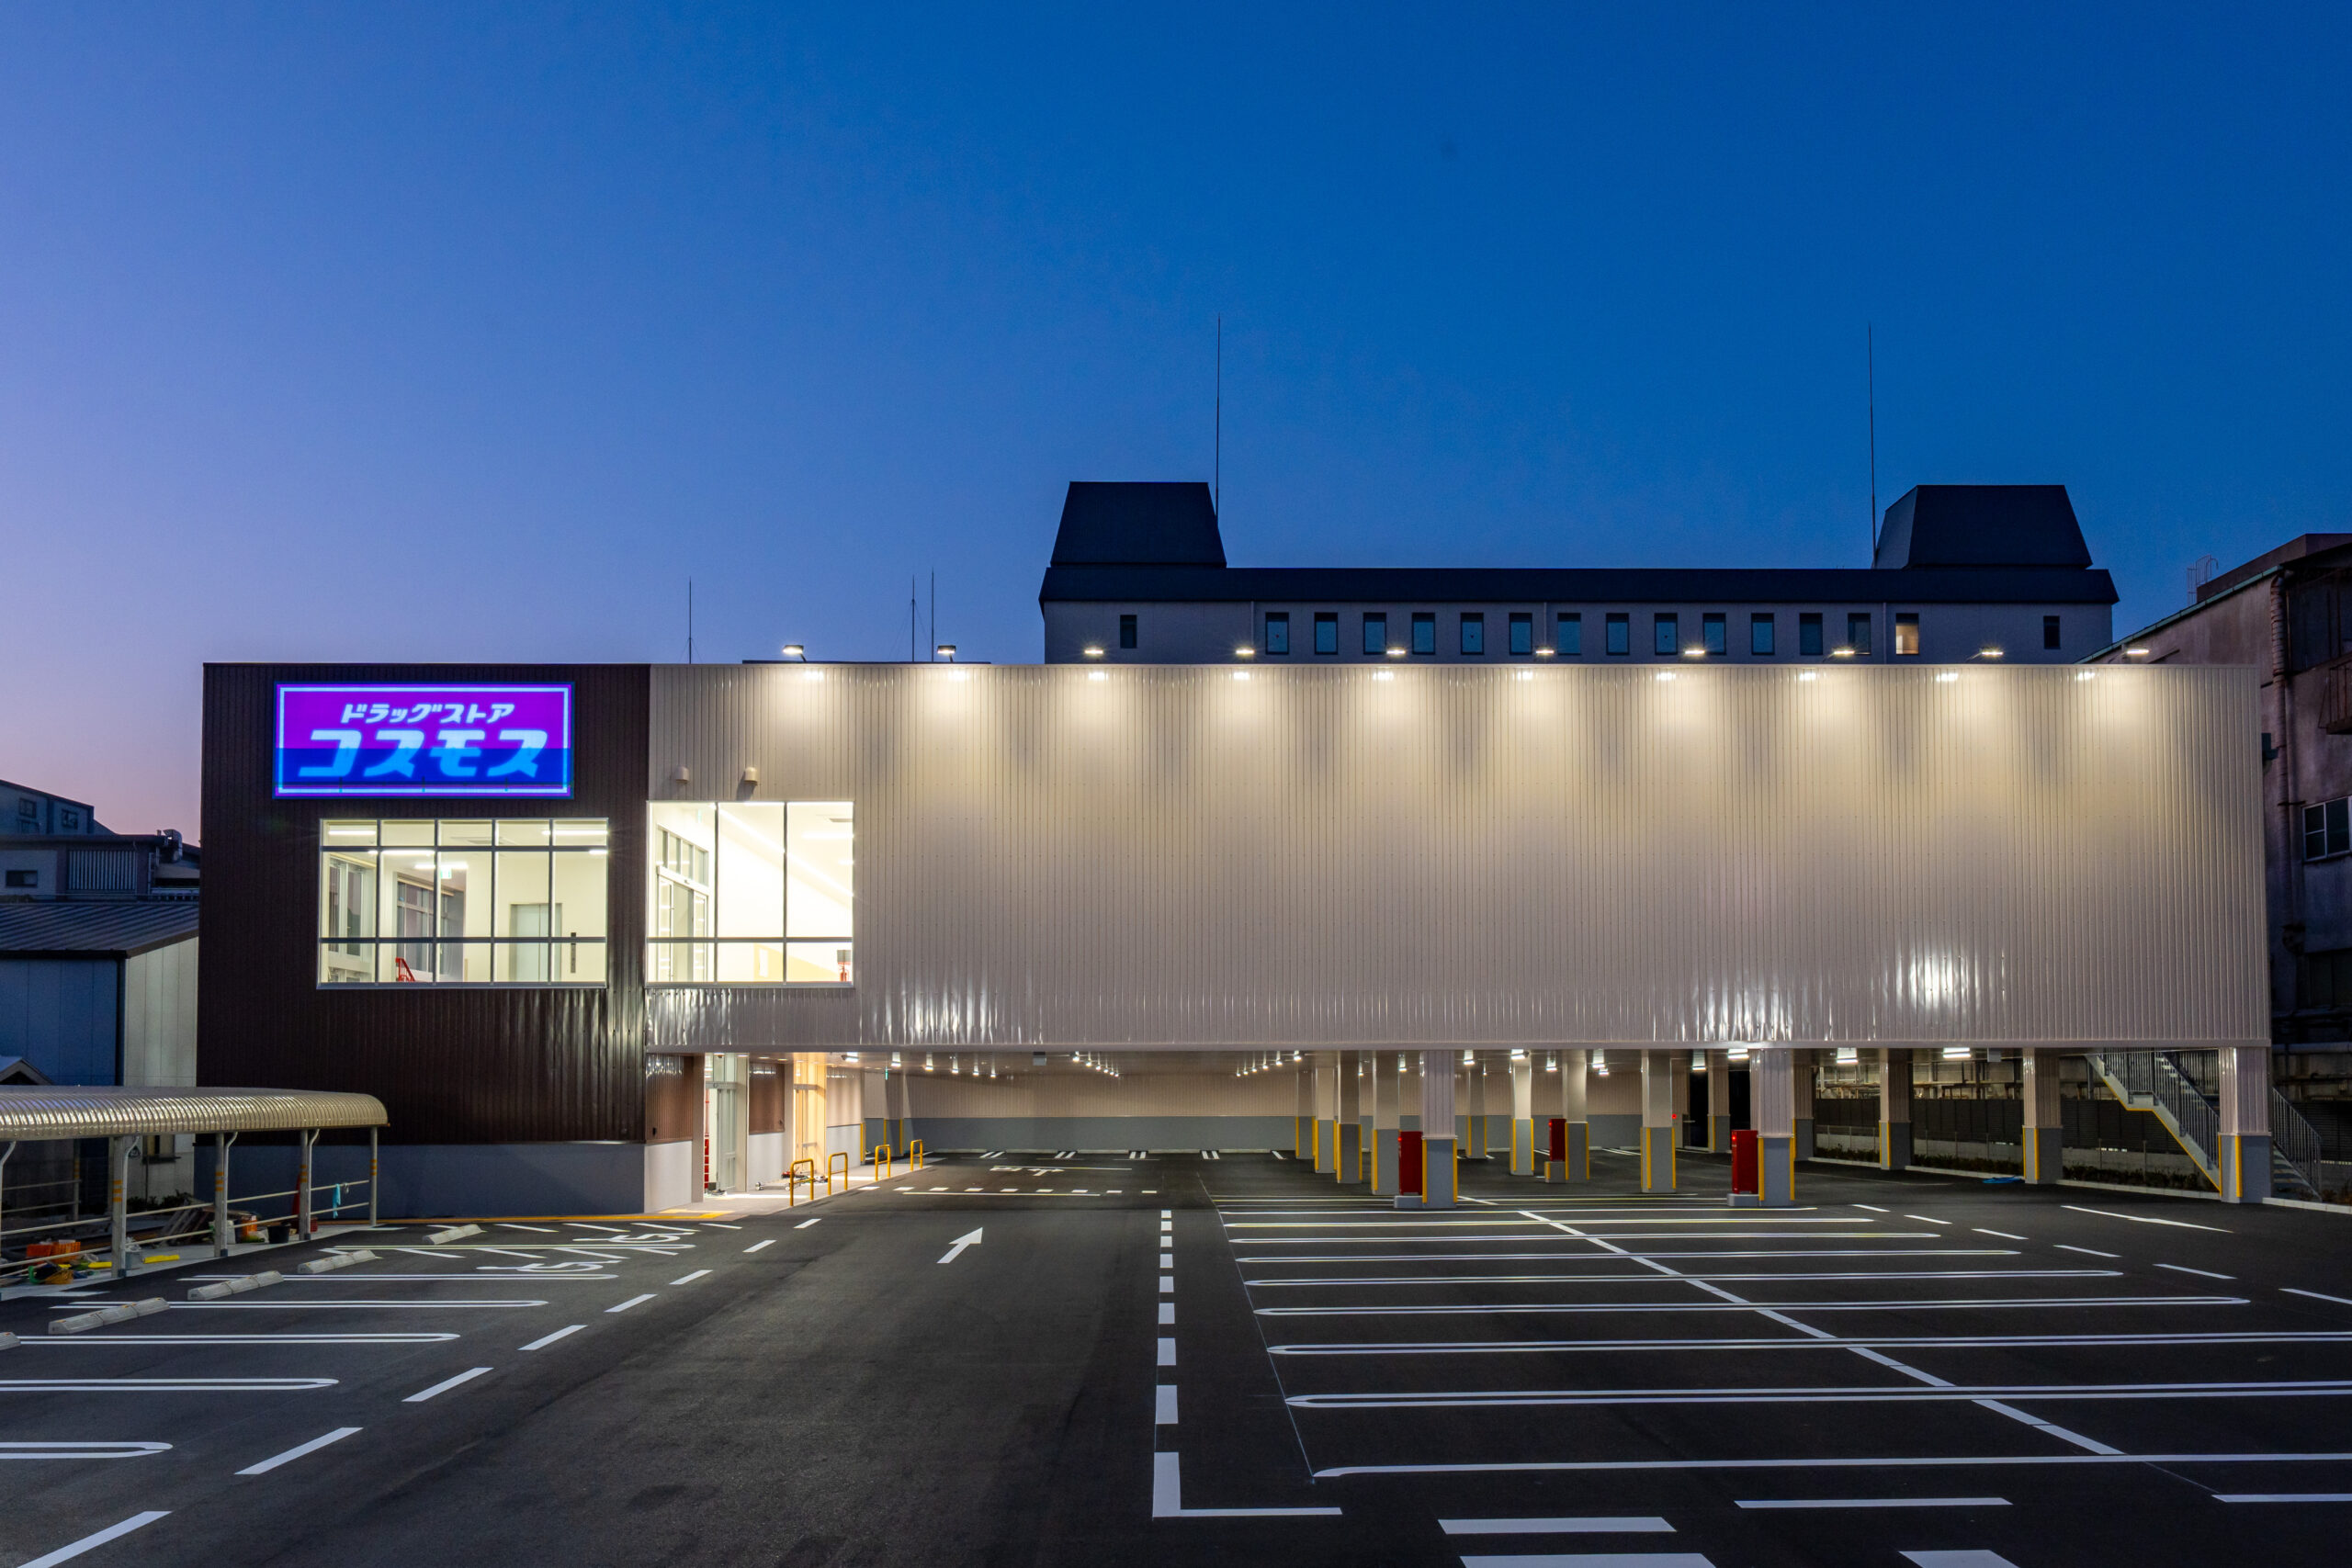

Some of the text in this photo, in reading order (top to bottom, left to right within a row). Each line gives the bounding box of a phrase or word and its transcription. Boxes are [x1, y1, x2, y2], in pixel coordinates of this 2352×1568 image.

[341, 703, 515, 724] ドラッグストア
[298, 729, 548, 778] コスモス
